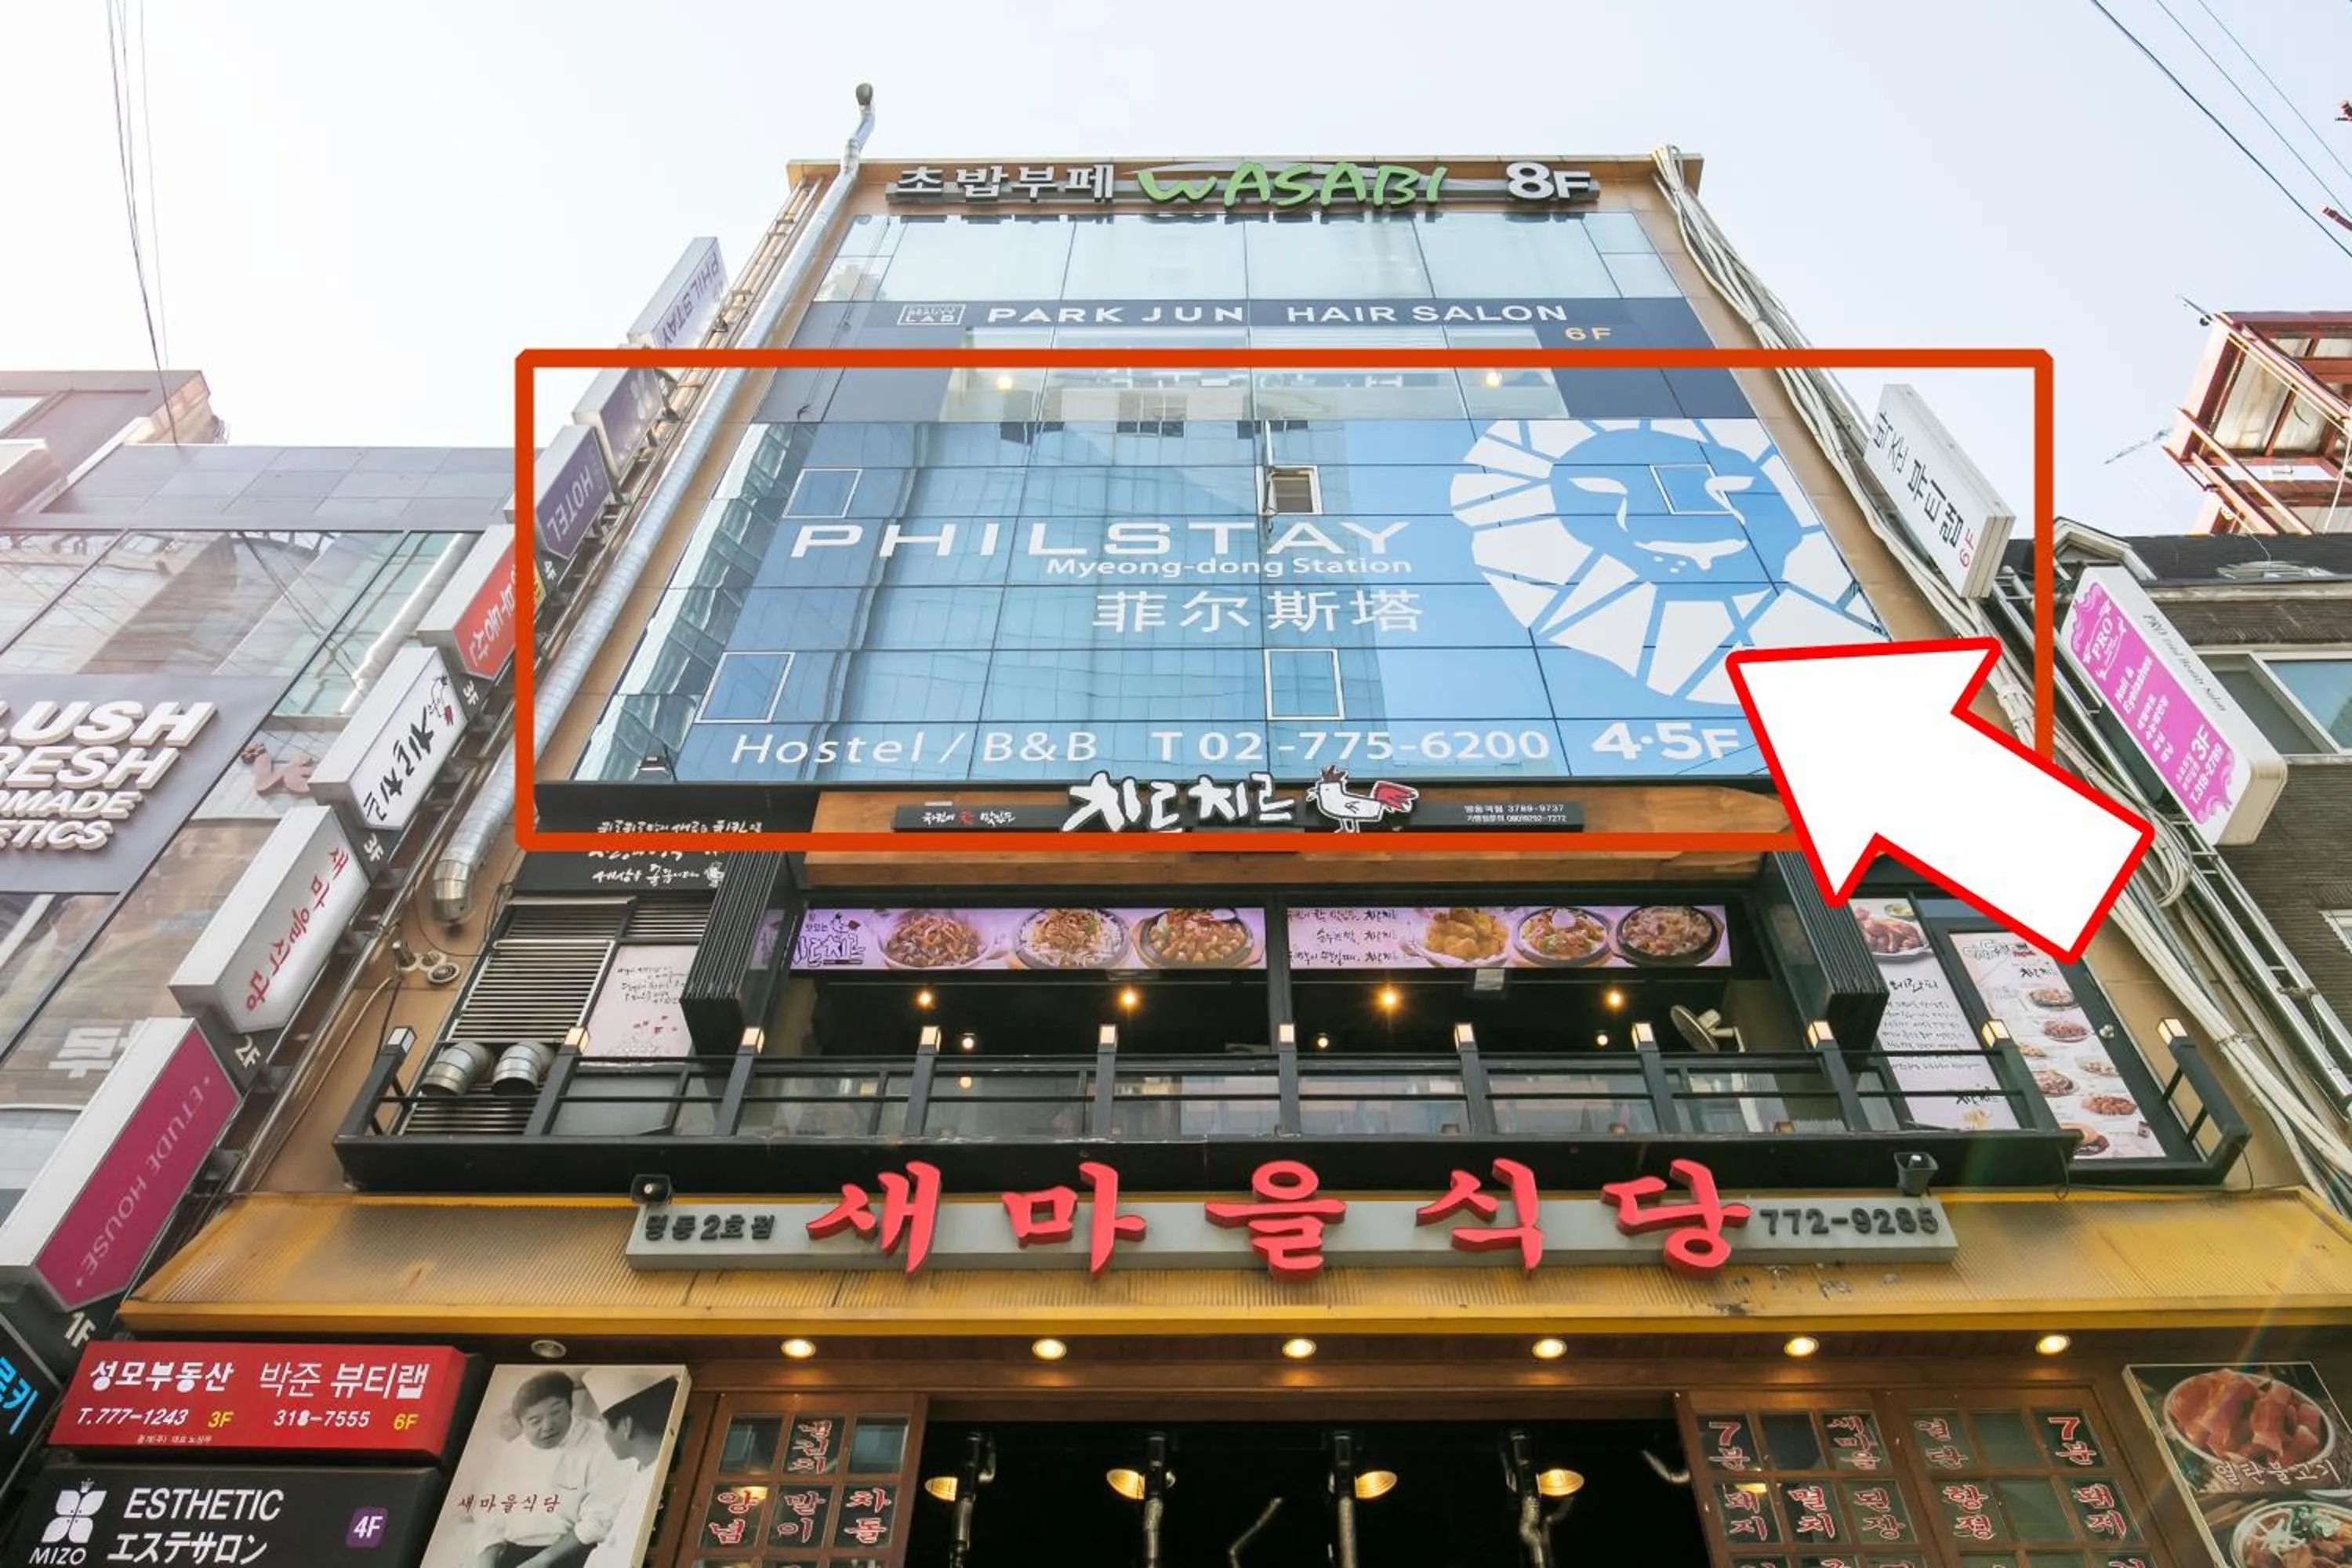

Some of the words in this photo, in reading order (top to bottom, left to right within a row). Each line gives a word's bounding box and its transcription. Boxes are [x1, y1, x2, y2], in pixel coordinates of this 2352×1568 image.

[895, 163, 1114, 202] 초밥부페
[1137, 161, 1449, 208] WASABI
[1505, 161, 1591, 200] 8F
[662, 252, 720, 349] PHILSTAY
[987, 307, 1124, 323] PARK
[1141, 307, 1243, 322] JUN
[1286, 305, 1399, 322] HAIR
[1411, 304, 1567, 322] SALON
[1565, 325, 1613, 341] 6F
[546, 466, 594, 543] HOTEL
[790, 521, 1410, 557] PHILSTAY
[1046, 557, 1284, 578] Myeong-dong
[1293, 557, 1412, 575] Station
[1092, 589, 1424, 633] 菲尔斯塔
[462, 681, 479, 706] 3F
[0, 700, 217, 748] USH
[2190, 724, 2212, 760] 3F
[729, 731, 924, 764] Hostel
[982, 731, 1098, 762] B&B
[1152, 731, 1183, 761] T
[1062, 770, 1297, 833] 치르치르
[363, 833, 384, 862] 3F
[234, 1034, 262, 1069] 2F
[145, 1088, 206, 1171] ETUDE
[79, 1176, 147, 1278] HOUSE
[644, 1214, 775, 1241] 명동2호점
[808, 1158, 1751, 1284] 새마을식당
[64, 1310, 97, 1348] 1F
[89, 1359, 234, 1394] 성모부동산
[258, 1360, 321, 1399] 박준
[329, 1361, 430, 1400] 뷰티랩
[207, 1411, 234, 1428] 3F
[393, 1412, 418, 1431] 6F
[122, 1486, 285, 1522] ESTHETIC
[458, 1493, 561, 1514] 새마을식당
[352, 1515, 383, 1539] 4F
[28, 1546, 88, 1566] MIZO
[106, 1530, 269, 1566] エステサロン
